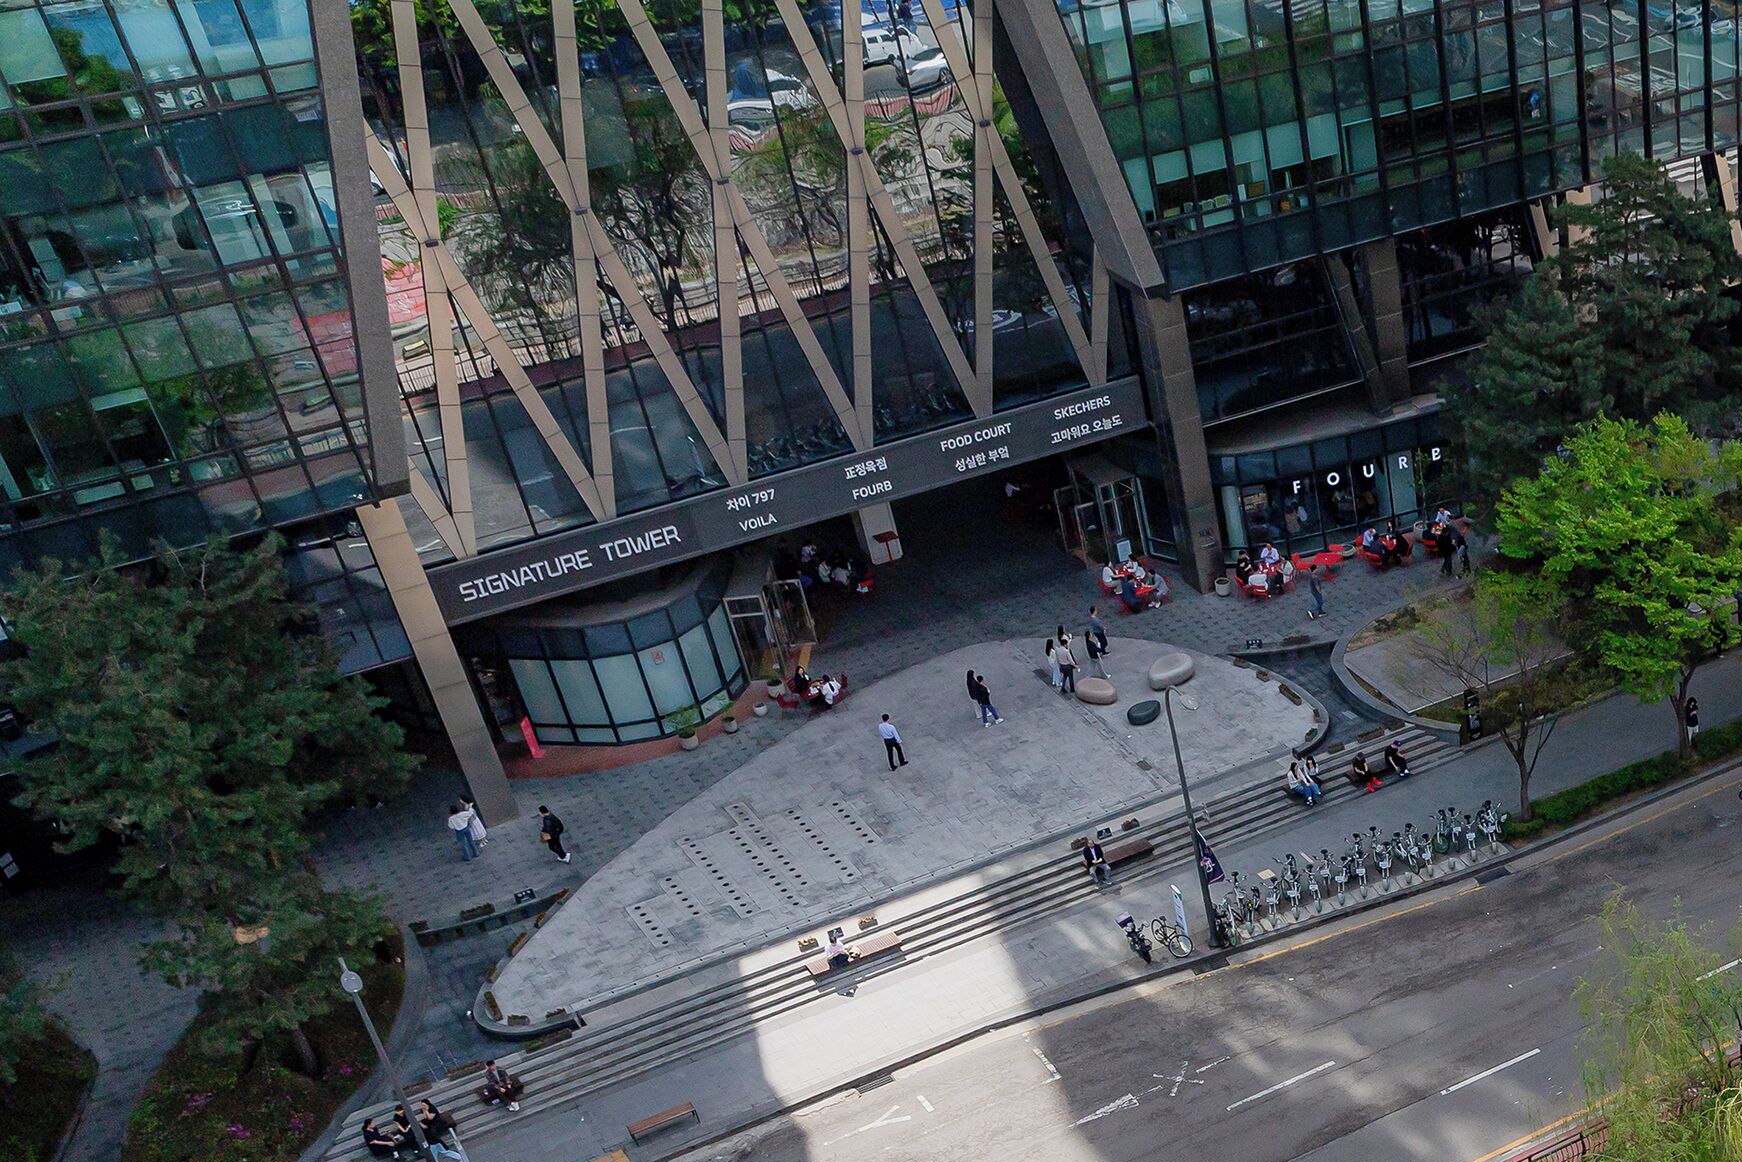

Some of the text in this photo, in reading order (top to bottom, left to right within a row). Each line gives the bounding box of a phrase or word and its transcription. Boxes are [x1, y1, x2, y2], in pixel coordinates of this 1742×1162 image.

[1054, 395, 1111, 420] SKECHERS
[940, 422, 1012, 452] FOOD COURT
[1051, 414, 1123, 444] 고마워요 오늘도
[955, 452, 987, 472] 성실한
[726, 488, 775, 511] 차이 797
[852, 480, 893, 500] FOURB
[739, 513, 778, 532] VOILA
[459, 525, 681, 602] SIGNATURE TOWER
